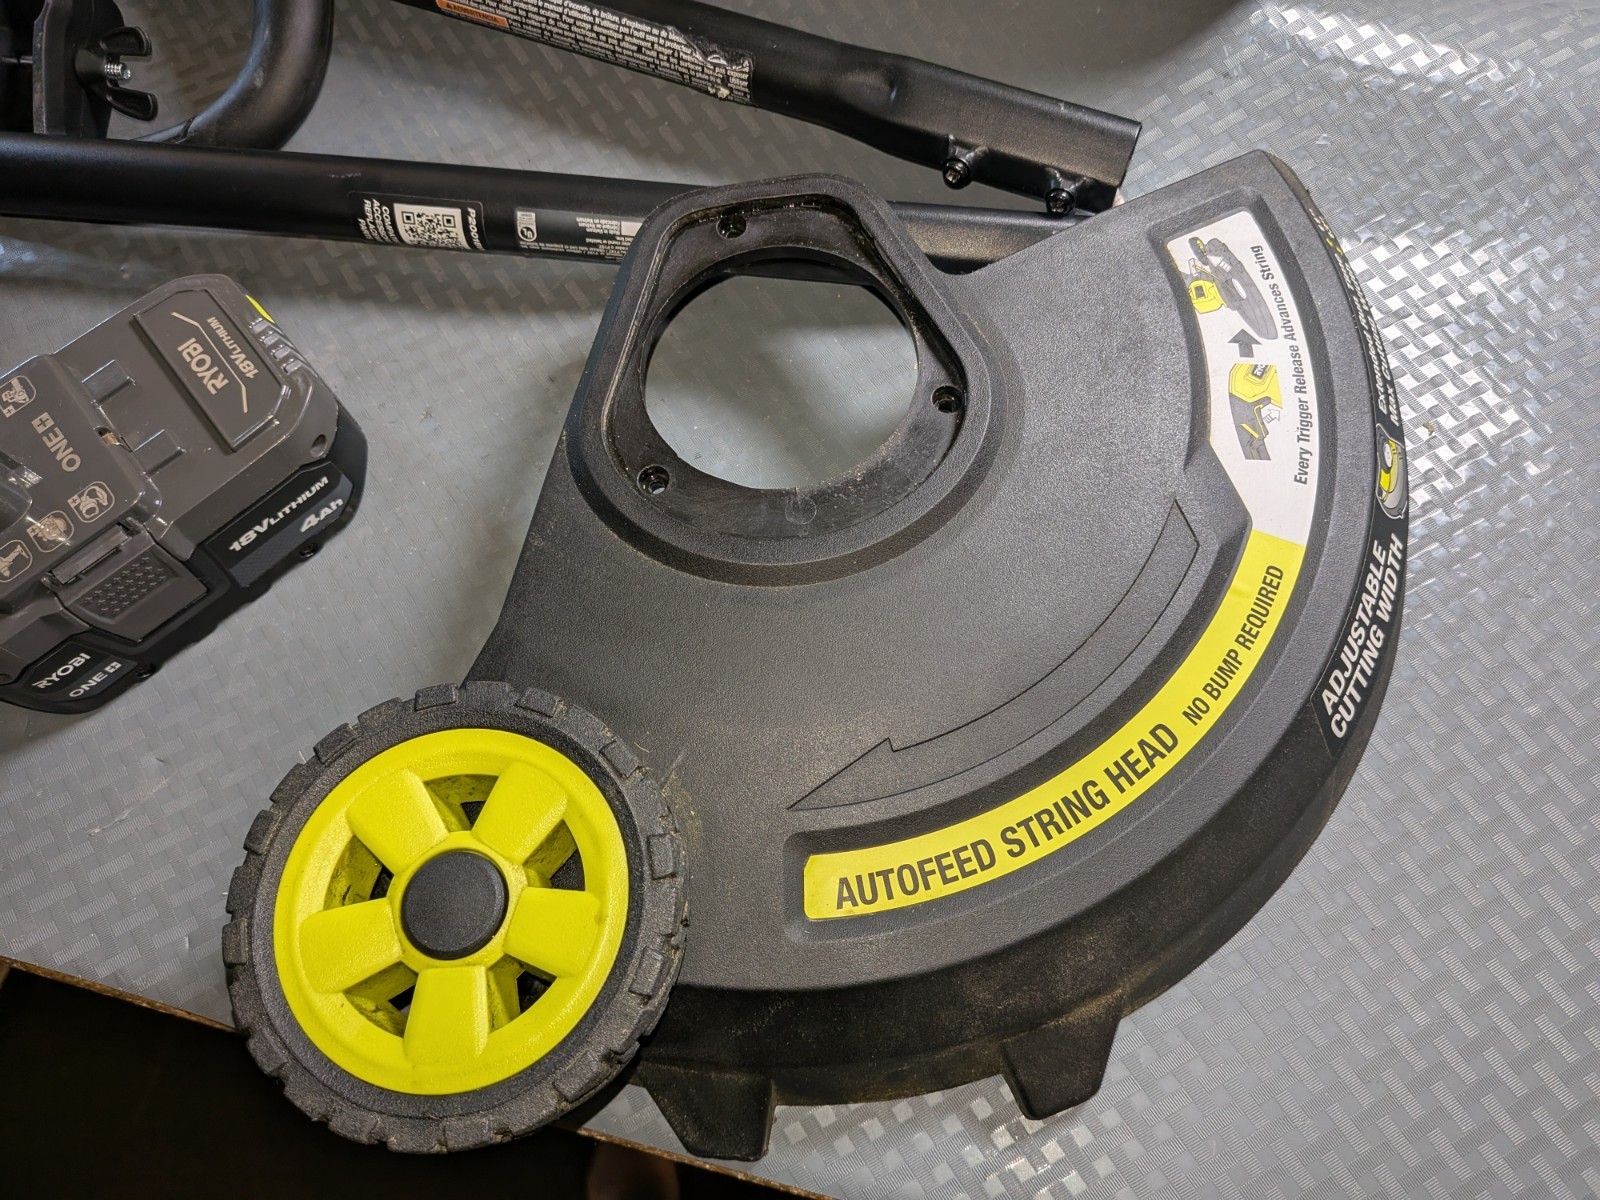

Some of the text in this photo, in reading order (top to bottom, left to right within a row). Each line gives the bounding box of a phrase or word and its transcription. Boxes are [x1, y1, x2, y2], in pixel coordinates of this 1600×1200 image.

[177, 337, 230, 395] RYOBI
[1250, 245, 1313, 485] Every Trigger Release Advances String
[1366, 328, 1388, 416] Extended
[299, 498, 344, 533] 4Ah
[32, 652, 91, 690] RYOBI
[1321, 539, 1387, 716] ADJUSTABLE
[1331, 533, 1404, 739] CUTTING WIDTH
[836, 564, 1285, 910] AUTOFEED STRING HEAD NO BUMP REQUIRED
